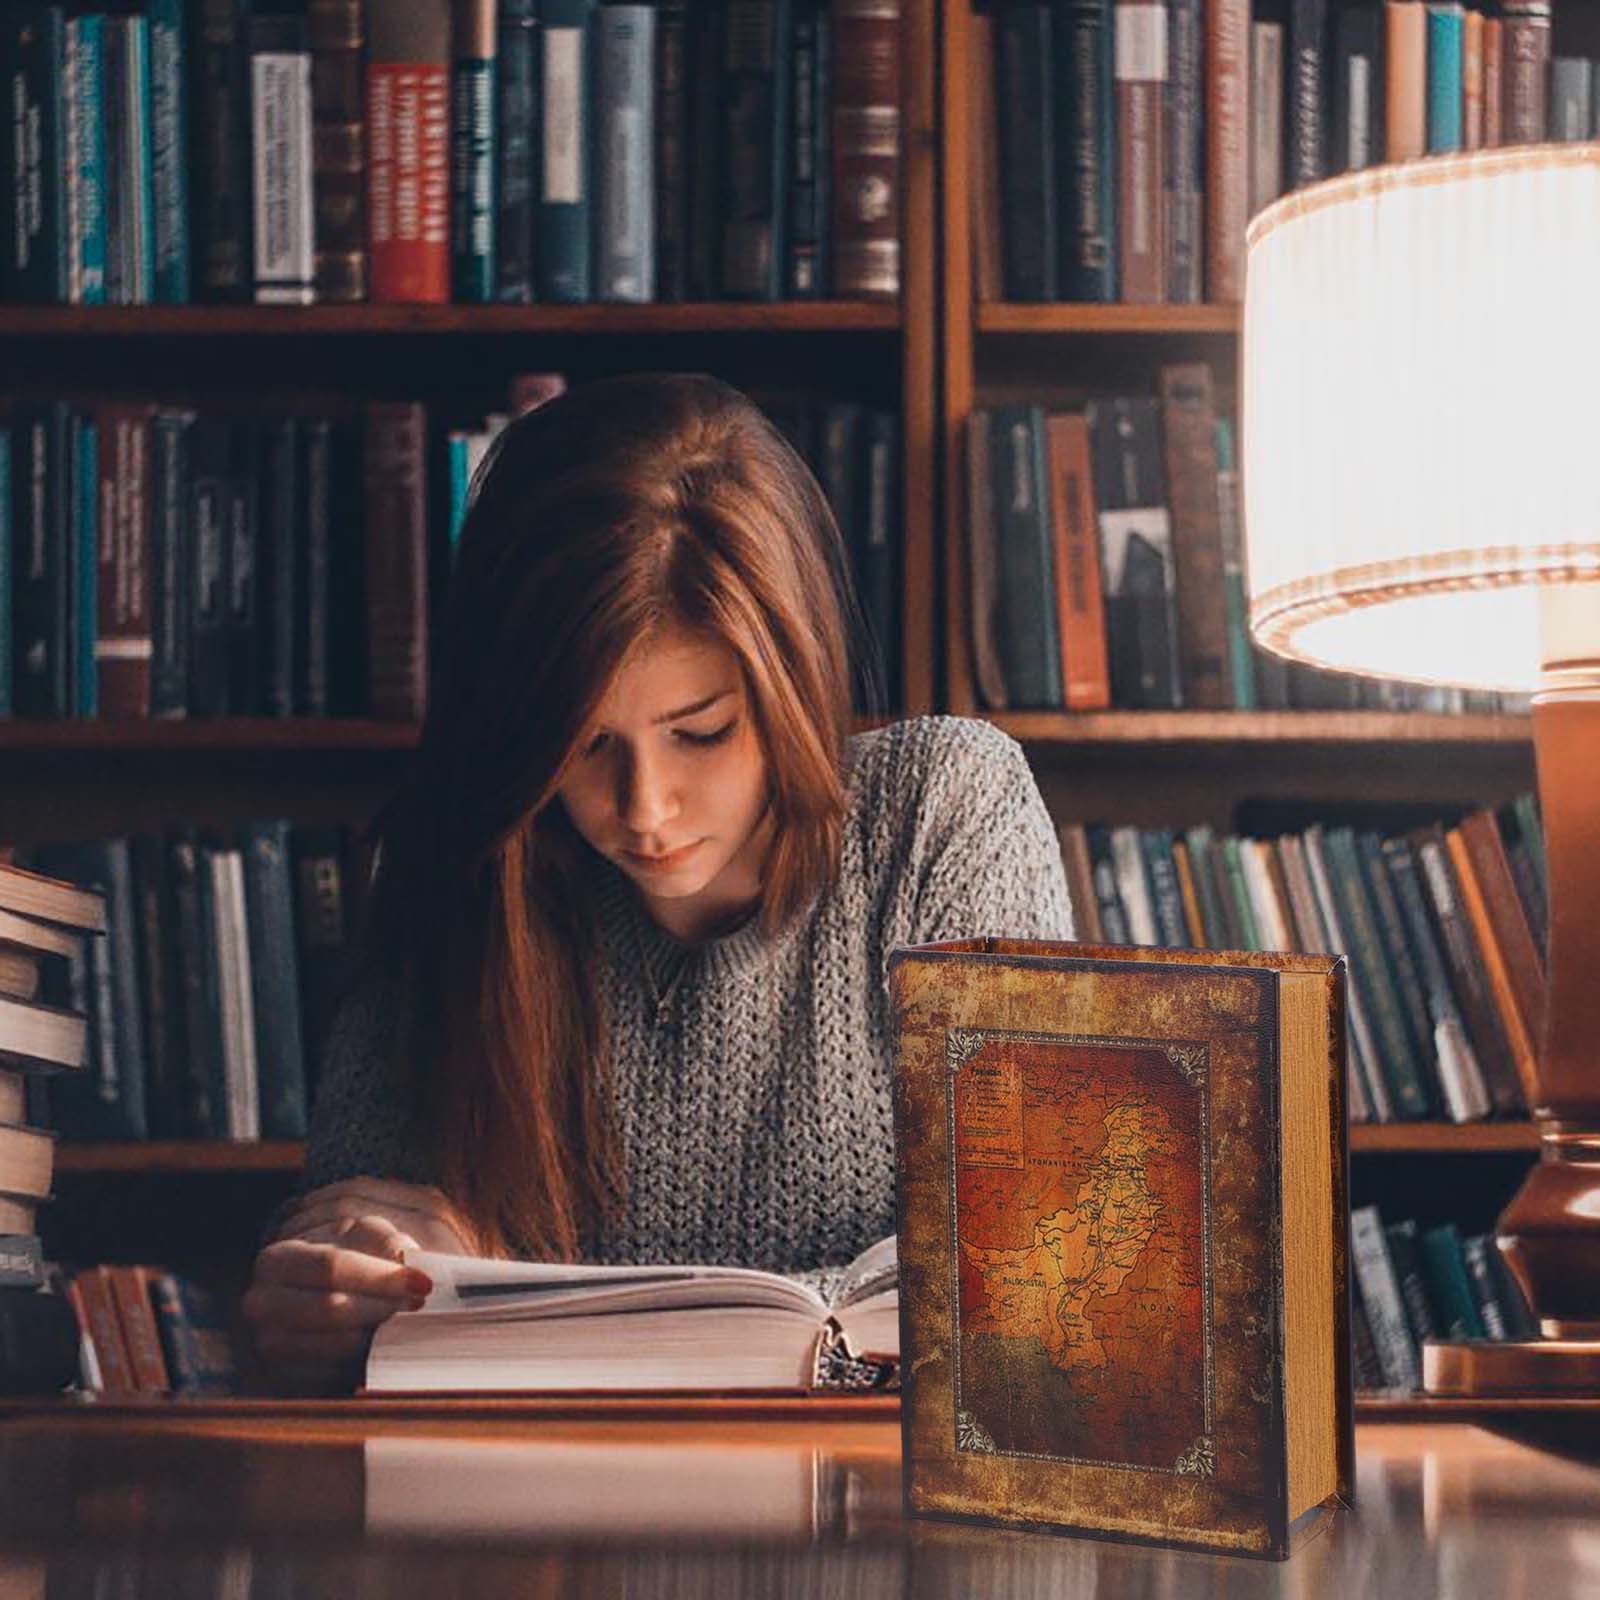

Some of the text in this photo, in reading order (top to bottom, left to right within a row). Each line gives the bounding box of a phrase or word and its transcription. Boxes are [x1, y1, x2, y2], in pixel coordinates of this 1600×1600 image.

[1027, 1157, 1083, 1168] AFGHANISTAN
[1003, 1276, 1047, 1289] BALOCHISTAN
[1133, 1301, 1176, 1313] INDIA
